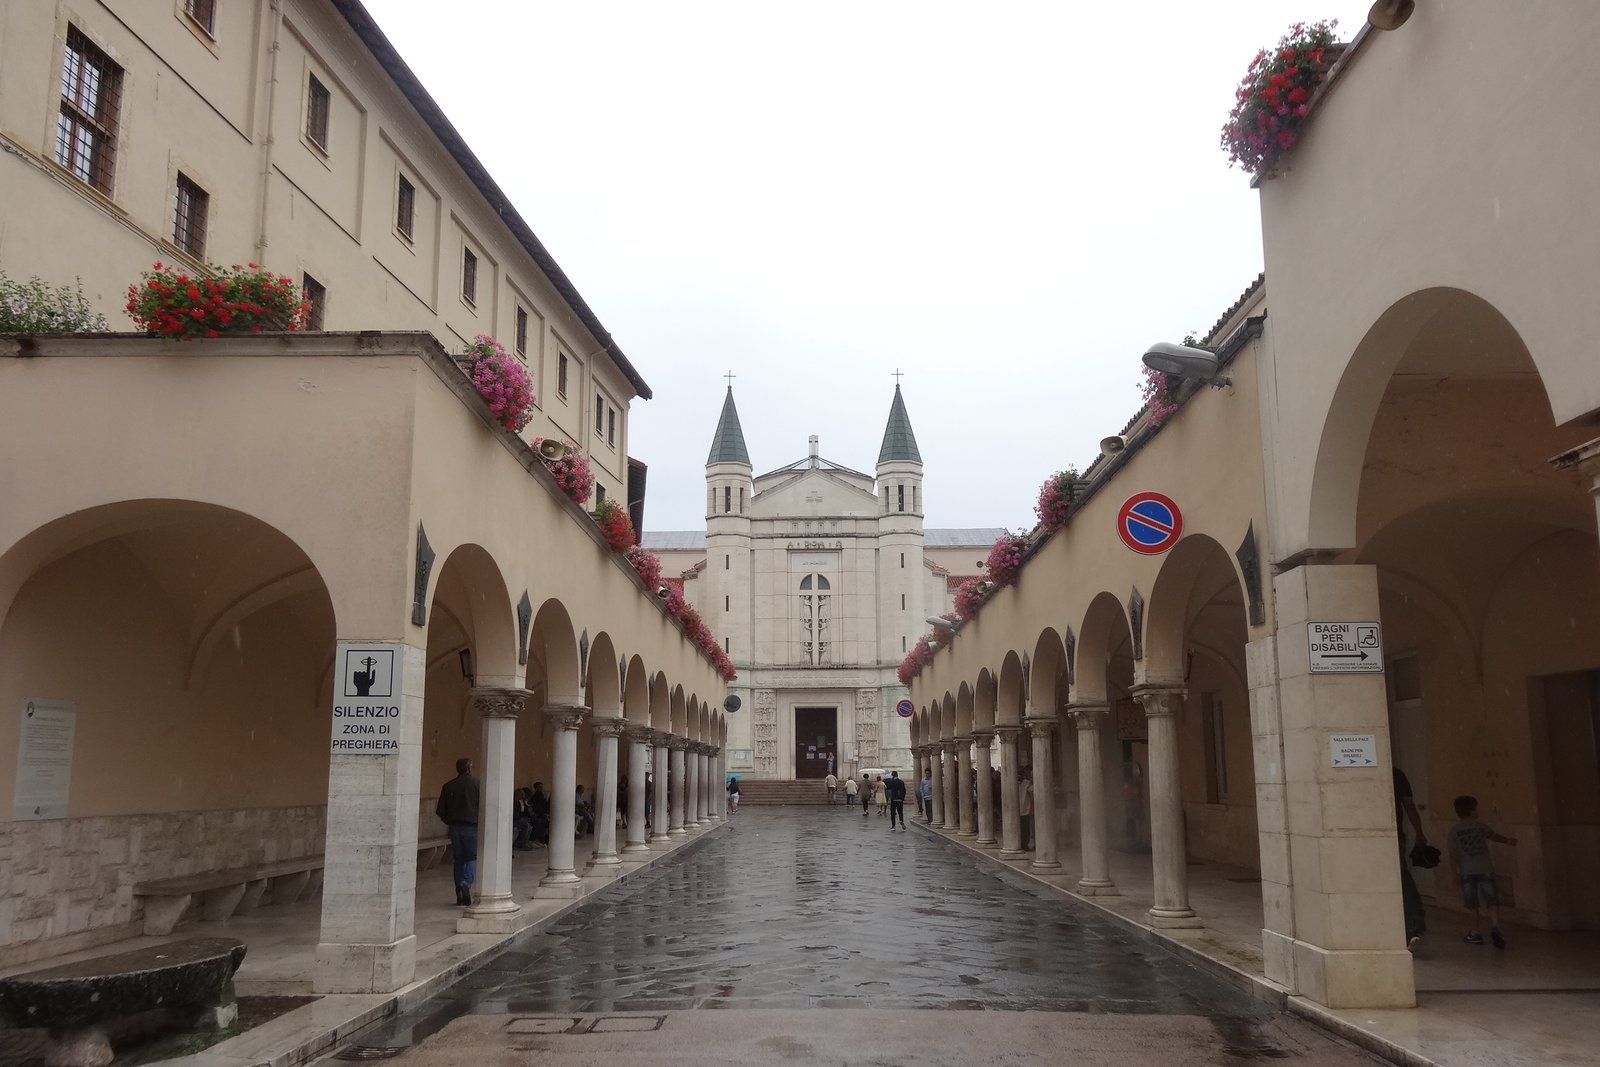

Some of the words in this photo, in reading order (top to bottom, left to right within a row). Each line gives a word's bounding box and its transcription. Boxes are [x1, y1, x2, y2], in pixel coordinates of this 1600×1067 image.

[1315, 624, 1349, 633] BAGNI
[1322, 634, 1344, 642] PER
[1311, 643, 1357, 651] DISABILI
[334, 706, 399, 718] SILENZIO
[343, 724, 375, 734] ZONA
[379, 724, 390, 734] DI
[332, 739, 399, 749] PREGHIERA
